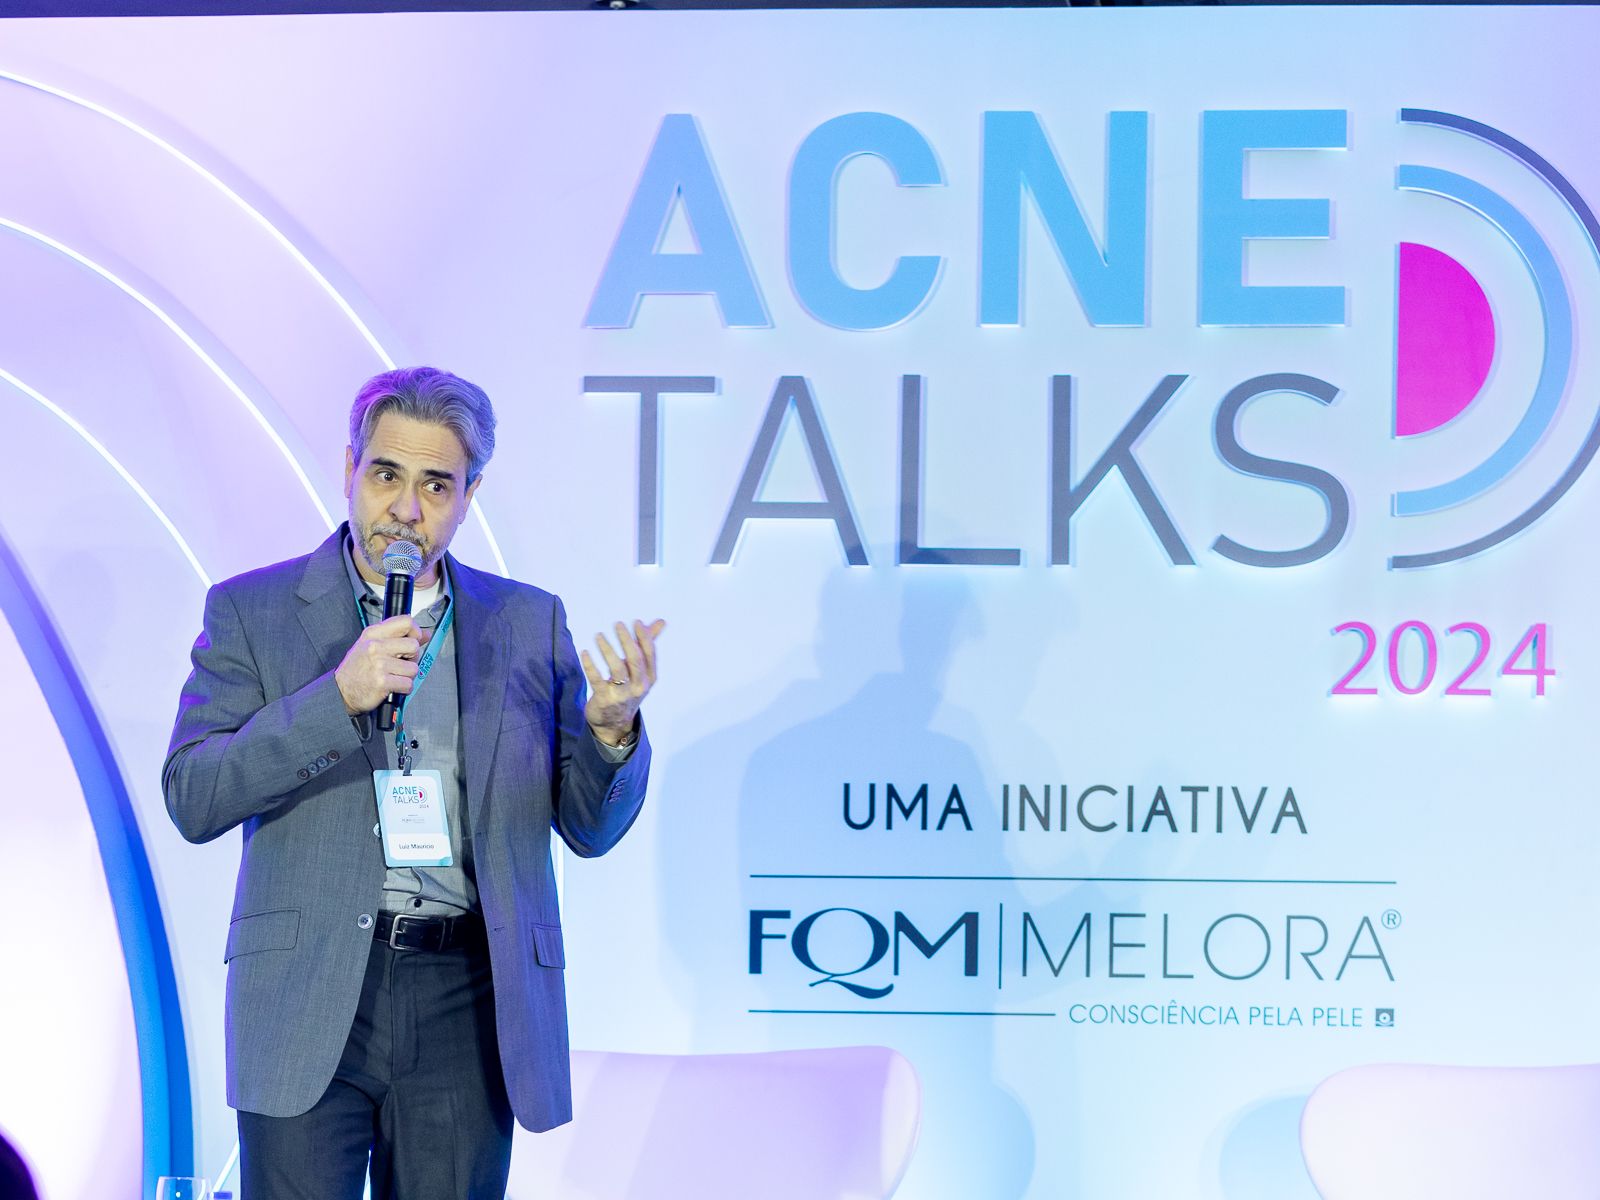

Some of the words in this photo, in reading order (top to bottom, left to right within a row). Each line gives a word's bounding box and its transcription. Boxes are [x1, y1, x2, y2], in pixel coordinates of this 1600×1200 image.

[583, 109, 1350, 331] ACNE
[582, 371, 1351, 569] TALKS
[1329, 619, 1556, 698] 2024
[392, 786, 418, 795] ACNE
[392, 795, 420, 804] TALKS
[842, 783, 974, 831] UMA
[1001, 784, 1309, 834] INICIATIVA
[748, 908, 979, 999] FQM
[1069, 1000, 1240, 1026] CONSCIÊNCIA
[1249, 1007, 1304, 1027] PELA
[1312, 1007, 1364, 1028] PELE
